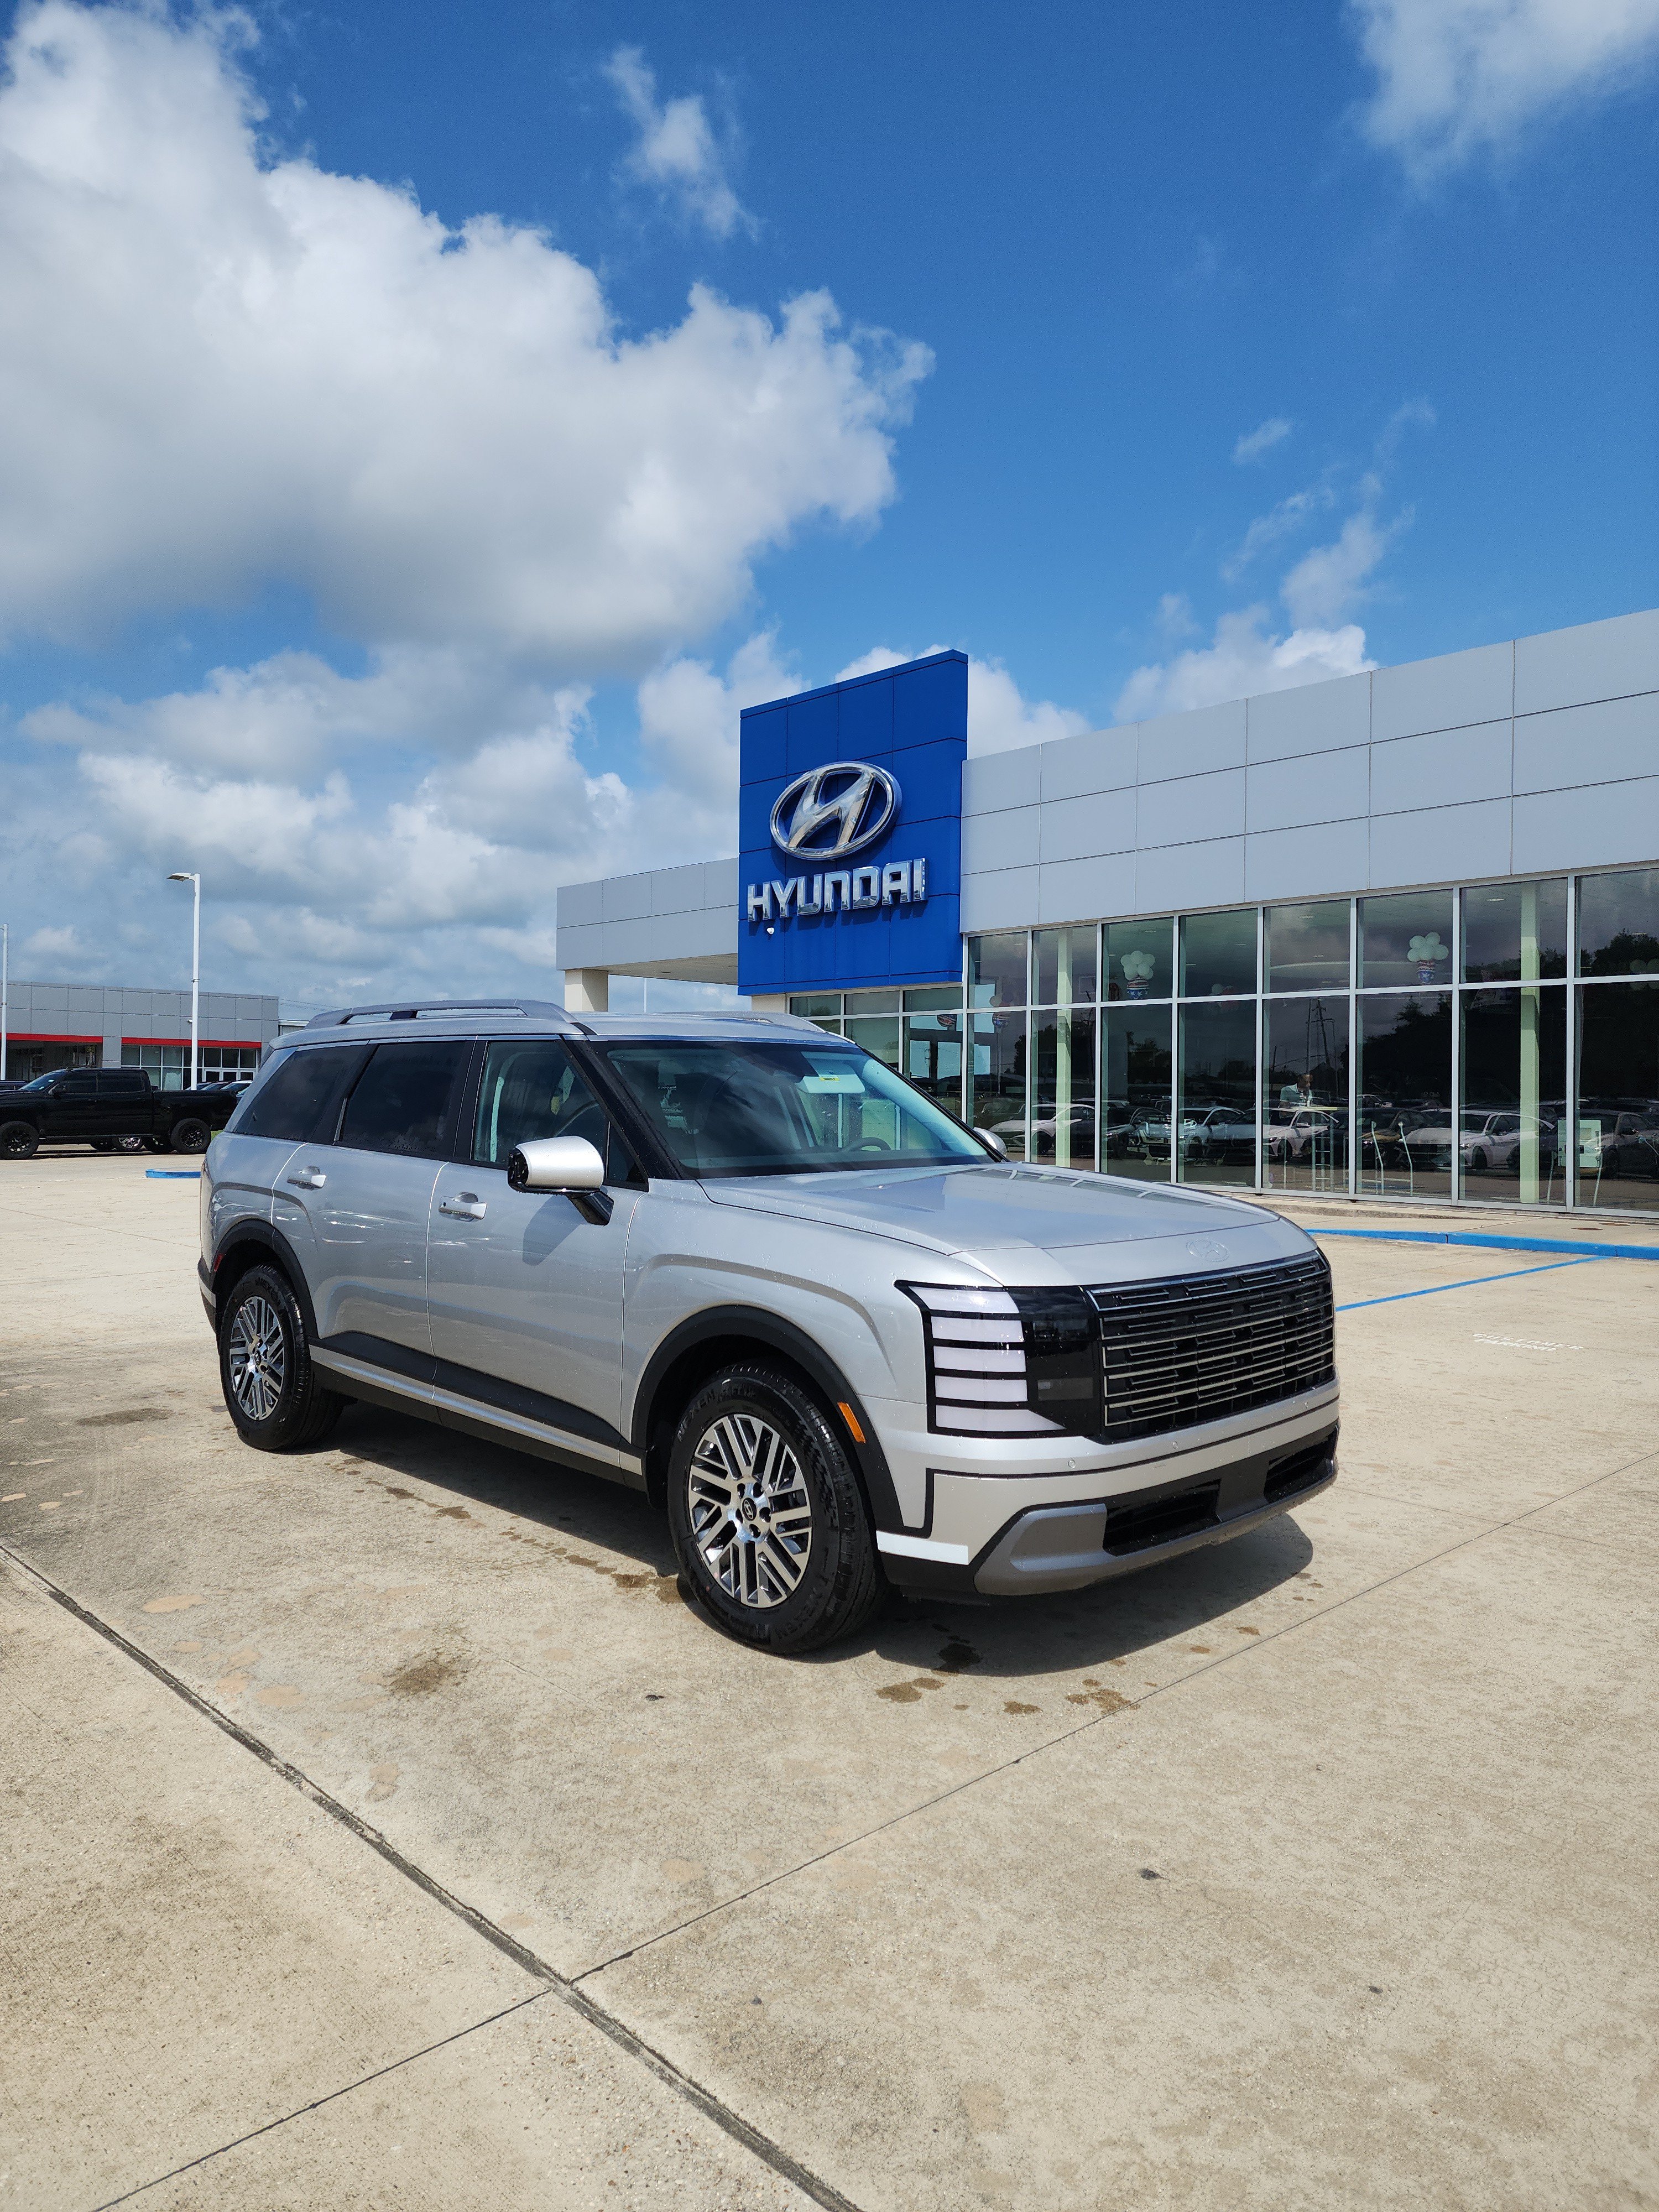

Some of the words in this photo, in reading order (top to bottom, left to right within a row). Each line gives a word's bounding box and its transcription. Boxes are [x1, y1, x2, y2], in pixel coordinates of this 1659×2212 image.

[748, 858, 928, 922] HYUNDAI
[1473, 1333, 1584, 1350] CUSTOMER
[1474, 1338, 1557, 1352] PARKING
[677, 1389, 716, 1442] NEXEN
